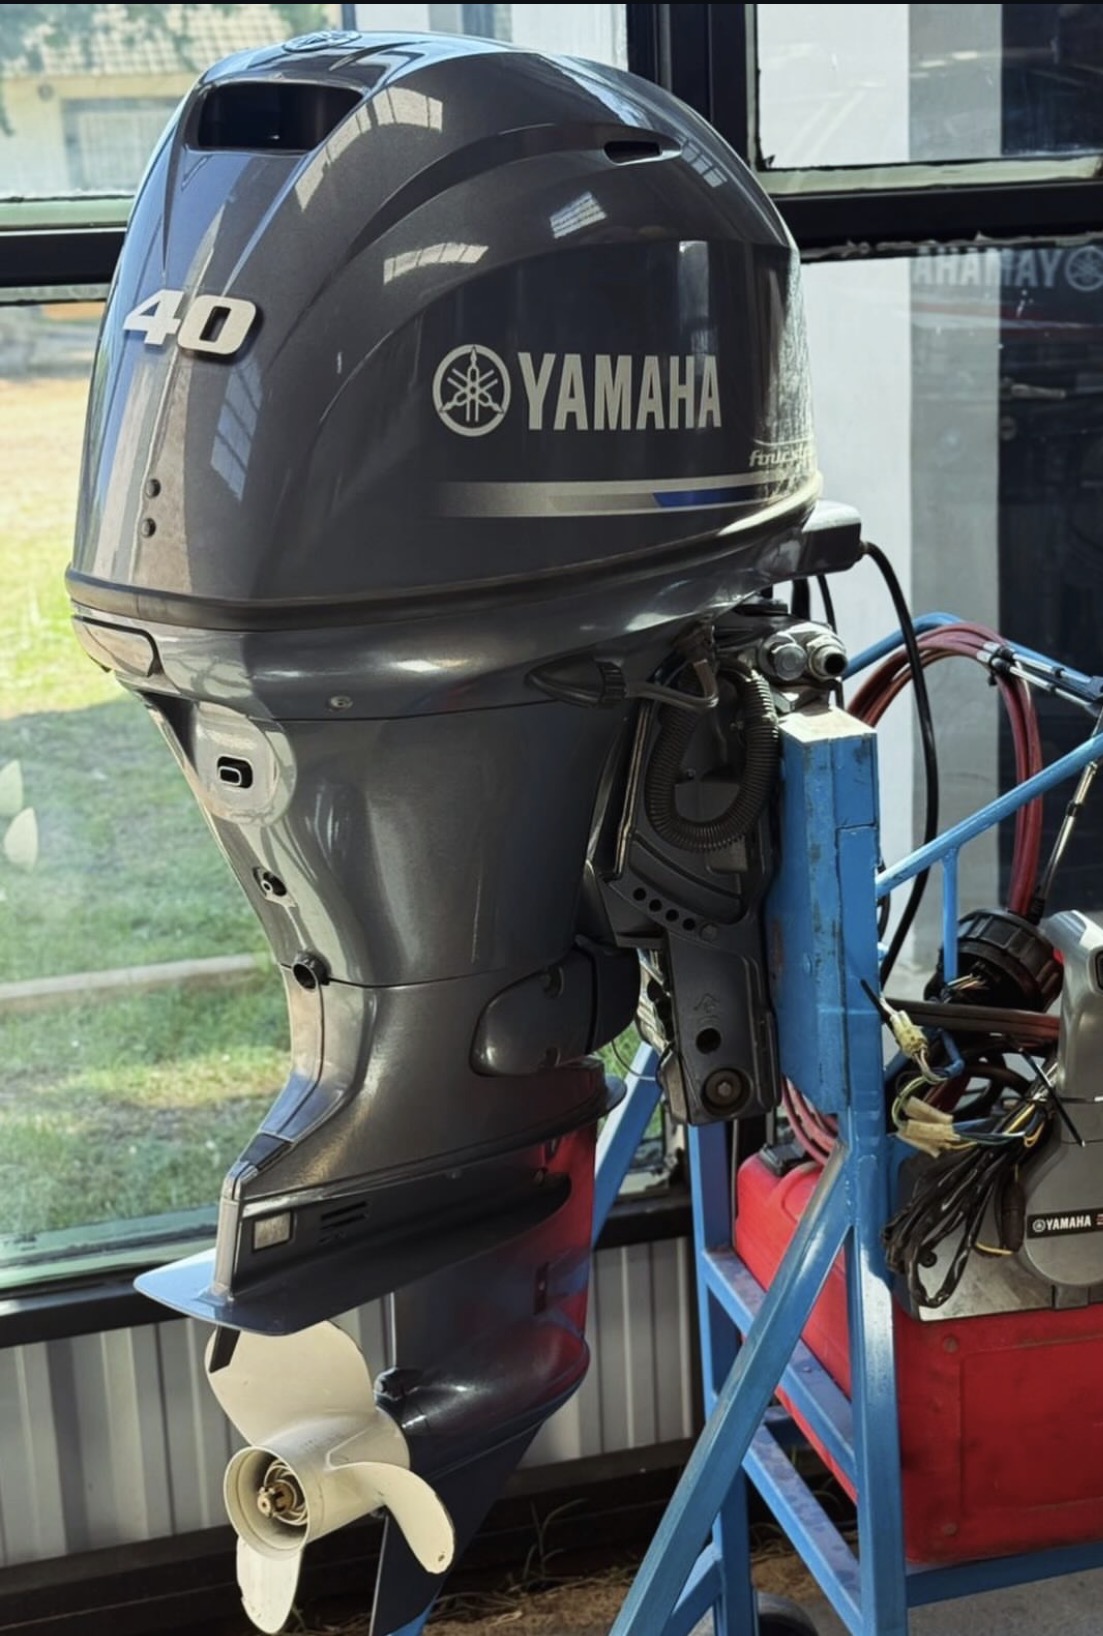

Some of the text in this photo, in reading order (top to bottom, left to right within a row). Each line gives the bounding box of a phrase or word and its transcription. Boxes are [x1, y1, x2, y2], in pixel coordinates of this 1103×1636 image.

[122, 288, 257, 355] 40
[517, 352, 722, 431] YAMAHA
[1046, 1215, 1092, 1231] YAMAHA
